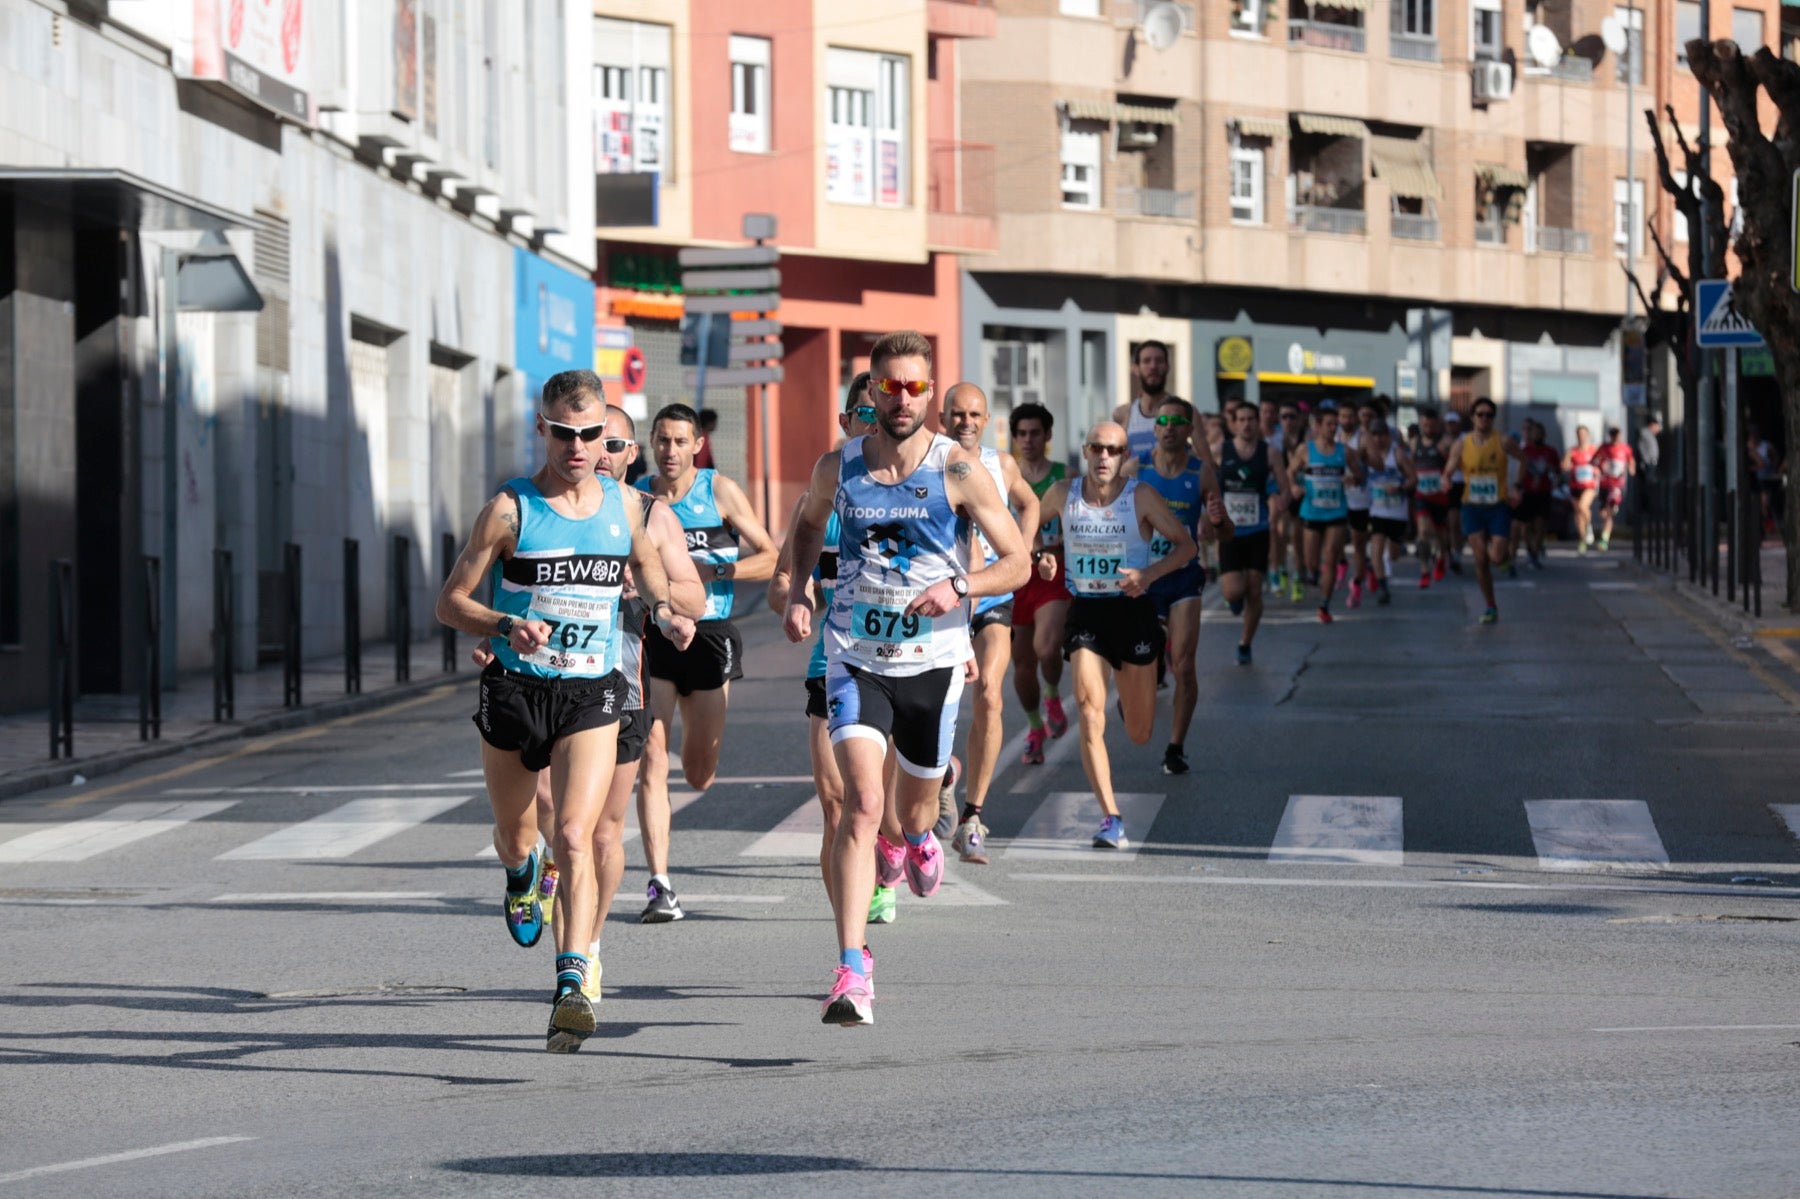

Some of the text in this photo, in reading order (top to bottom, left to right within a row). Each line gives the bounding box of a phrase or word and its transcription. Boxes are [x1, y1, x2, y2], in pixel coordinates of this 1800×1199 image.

[848, 507, 929, 519] TODO SUMA
[1070, 524, 1126, 534] MARACENA
[536, 559, 621, 583] BEWOR
[1076, 557, 1121, 575] 1197
[568, 600, 588, 610] PREMIO
[588, 602, 595, 610] DE
[865, 608, 919, 638] 679
[543, 618, 598, 649] 767
